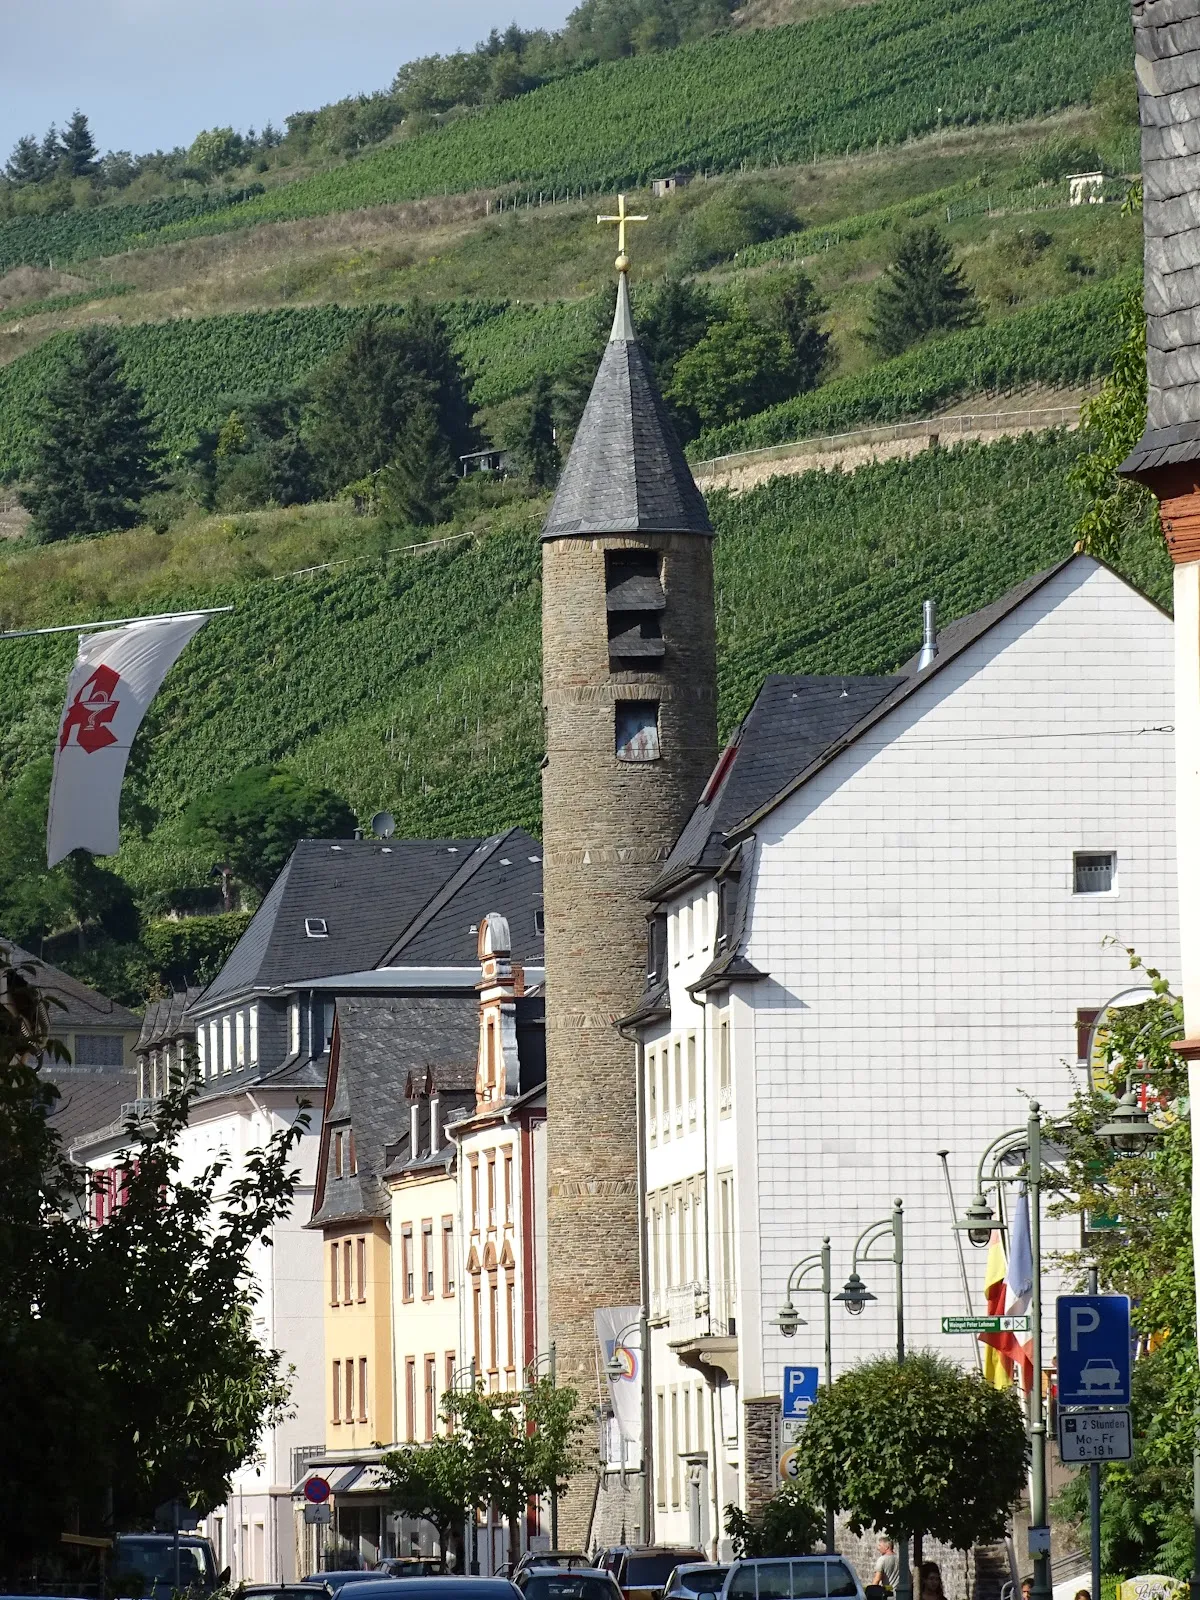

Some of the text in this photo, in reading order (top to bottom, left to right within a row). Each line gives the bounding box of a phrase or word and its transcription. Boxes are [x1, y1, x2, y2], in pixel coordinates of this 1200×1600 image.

[1070, 1306, 1100, 1352] P
[789, 1370, 805, 1393] P
[1082, 1419, 1125, 1430] 2 Stunden
